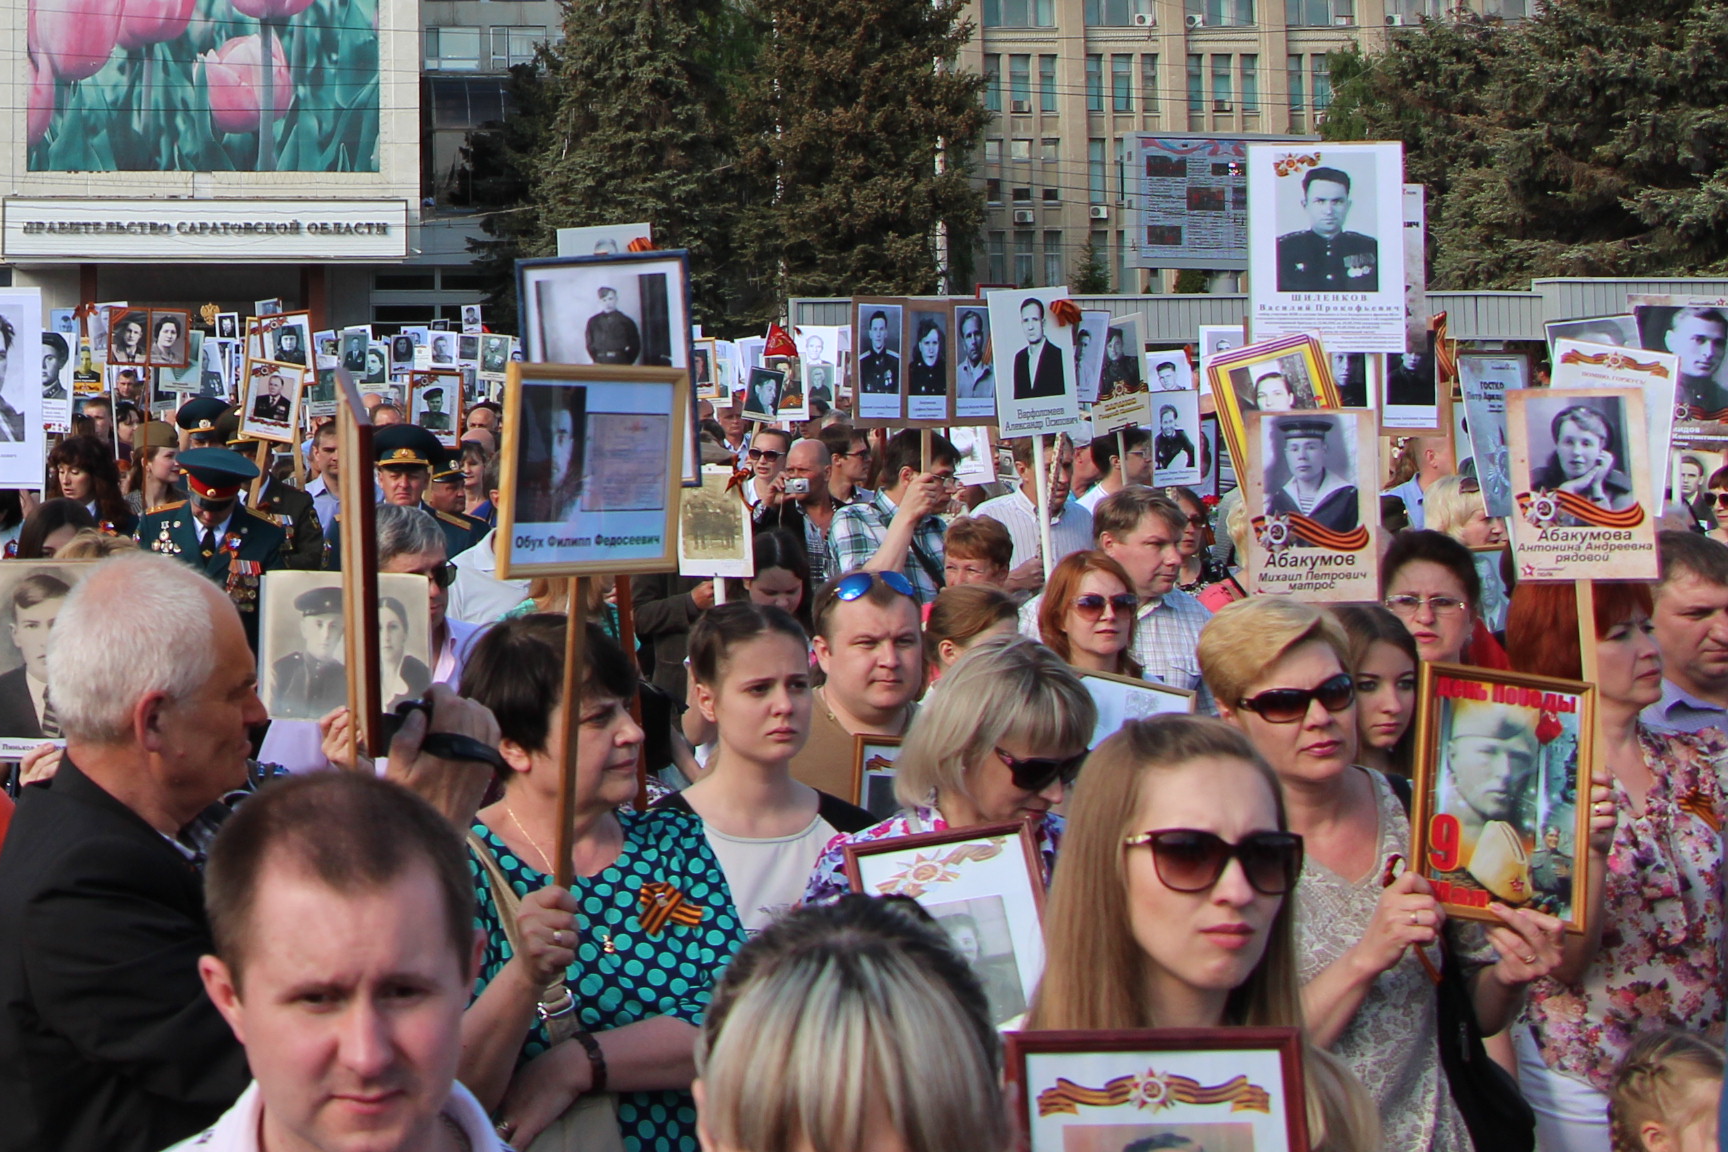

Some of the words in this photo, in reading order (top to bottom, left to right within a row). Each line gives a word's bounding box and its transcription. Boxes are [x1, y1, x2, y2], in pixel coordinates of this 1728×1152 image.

[22, 221, 171, 235] ПРАВИТЕЛЬСТВО
[176, 218, 301, 236] САРАТОВСКОЙ
[307, 221, 389, 236] ОБЛАСТИ
[1291, 294, 1367, 302] ШИЛЕНКОВ
[1259, 303, 1311, 311] Василий
[1315, 303, 1400, 312] Прокофьевич
[515, 535, 545, 552] Обух
[547, 535, 592, 548] Филипп
[594, 534, 661, 548] Федосеевич
[1537, 528, 1632, 545] Абакумова
[1517, 543, 1581, 552] Антонина
[1584, 542, 1653, 553] Андреевна
[1264, 552, 1356, 571] Абакумов
[1555, 552, 1610, 564] рядовой
[1258, 572, 1303, 583] Михаил
[1305, 570, 1368, 582] Петрович
[1288, 581, 1336, 592] матрос
[1436, 675, 1488, 702] День
[1492, 683, 1577, 714] Победы
[1428, 813, 1462, 872] 9
